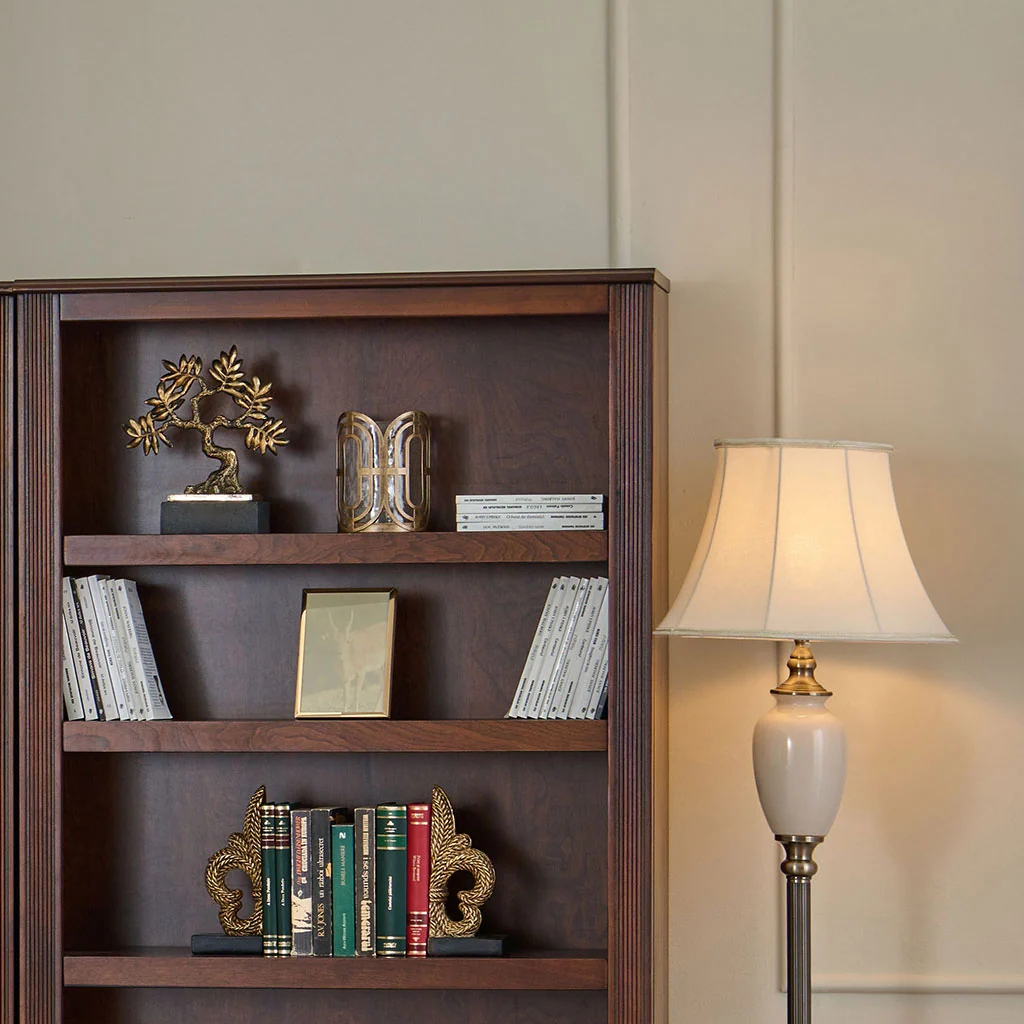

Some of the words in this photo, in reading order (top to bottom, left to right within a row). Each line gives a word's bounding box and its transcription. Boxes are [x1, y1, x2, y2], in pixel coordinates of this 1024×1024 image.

[316, 836, 324, 867] ultrasecret
[361, 869, 369, 899] spunea
[360, 899, 372, 951] temerarul
